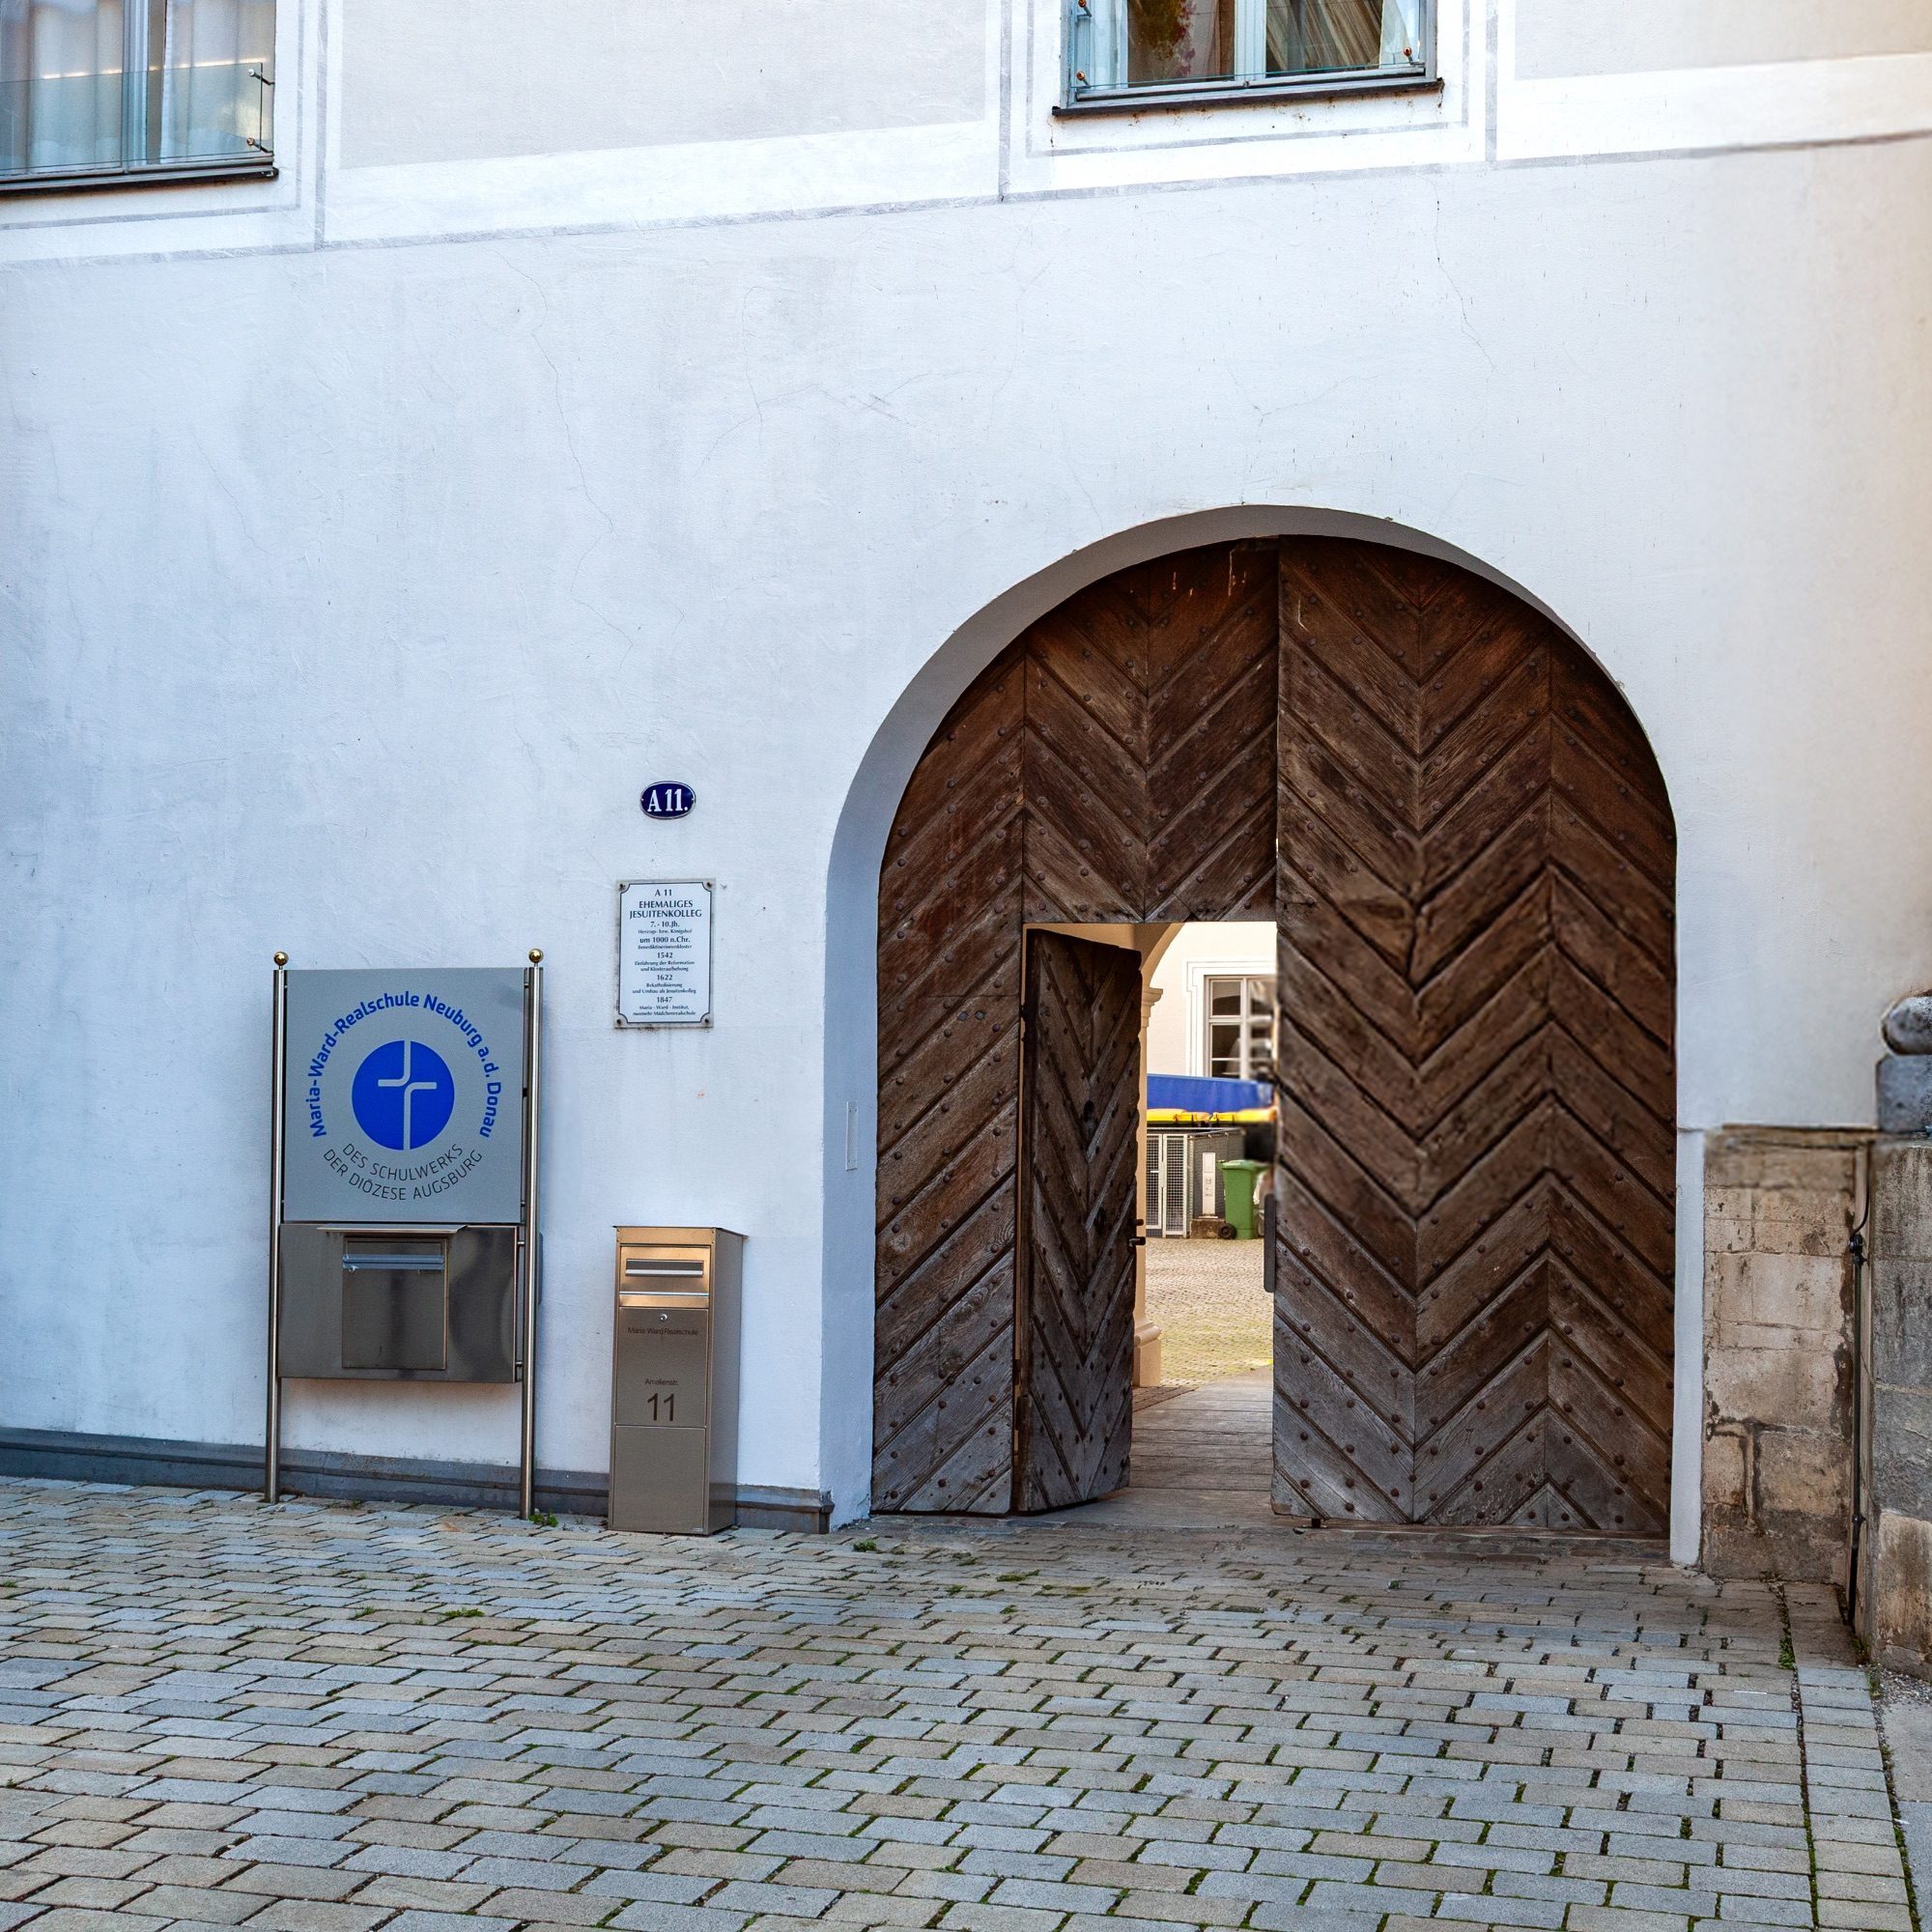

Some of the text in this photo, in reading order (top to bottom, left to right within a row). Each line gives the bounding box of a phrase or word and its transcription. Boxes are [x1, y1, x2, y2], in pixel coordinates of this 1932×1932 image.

[647, 788, 689, 812] A 11.
[629, 909, 702, 919] JESUITENKOLLEG
[305, 990, 420, 1138] Maria-Ward-Realschule
[423, 993, 483, 1048] Neuburg
[479, 1081, 502, 1138] Donau
[324, 1149, 483, 1201] DER DIÖZESE AUGSBURG
[342, 1143, 464, 1181] DES SCHULWERKS
[647, 1392, 674, 1421] 11
